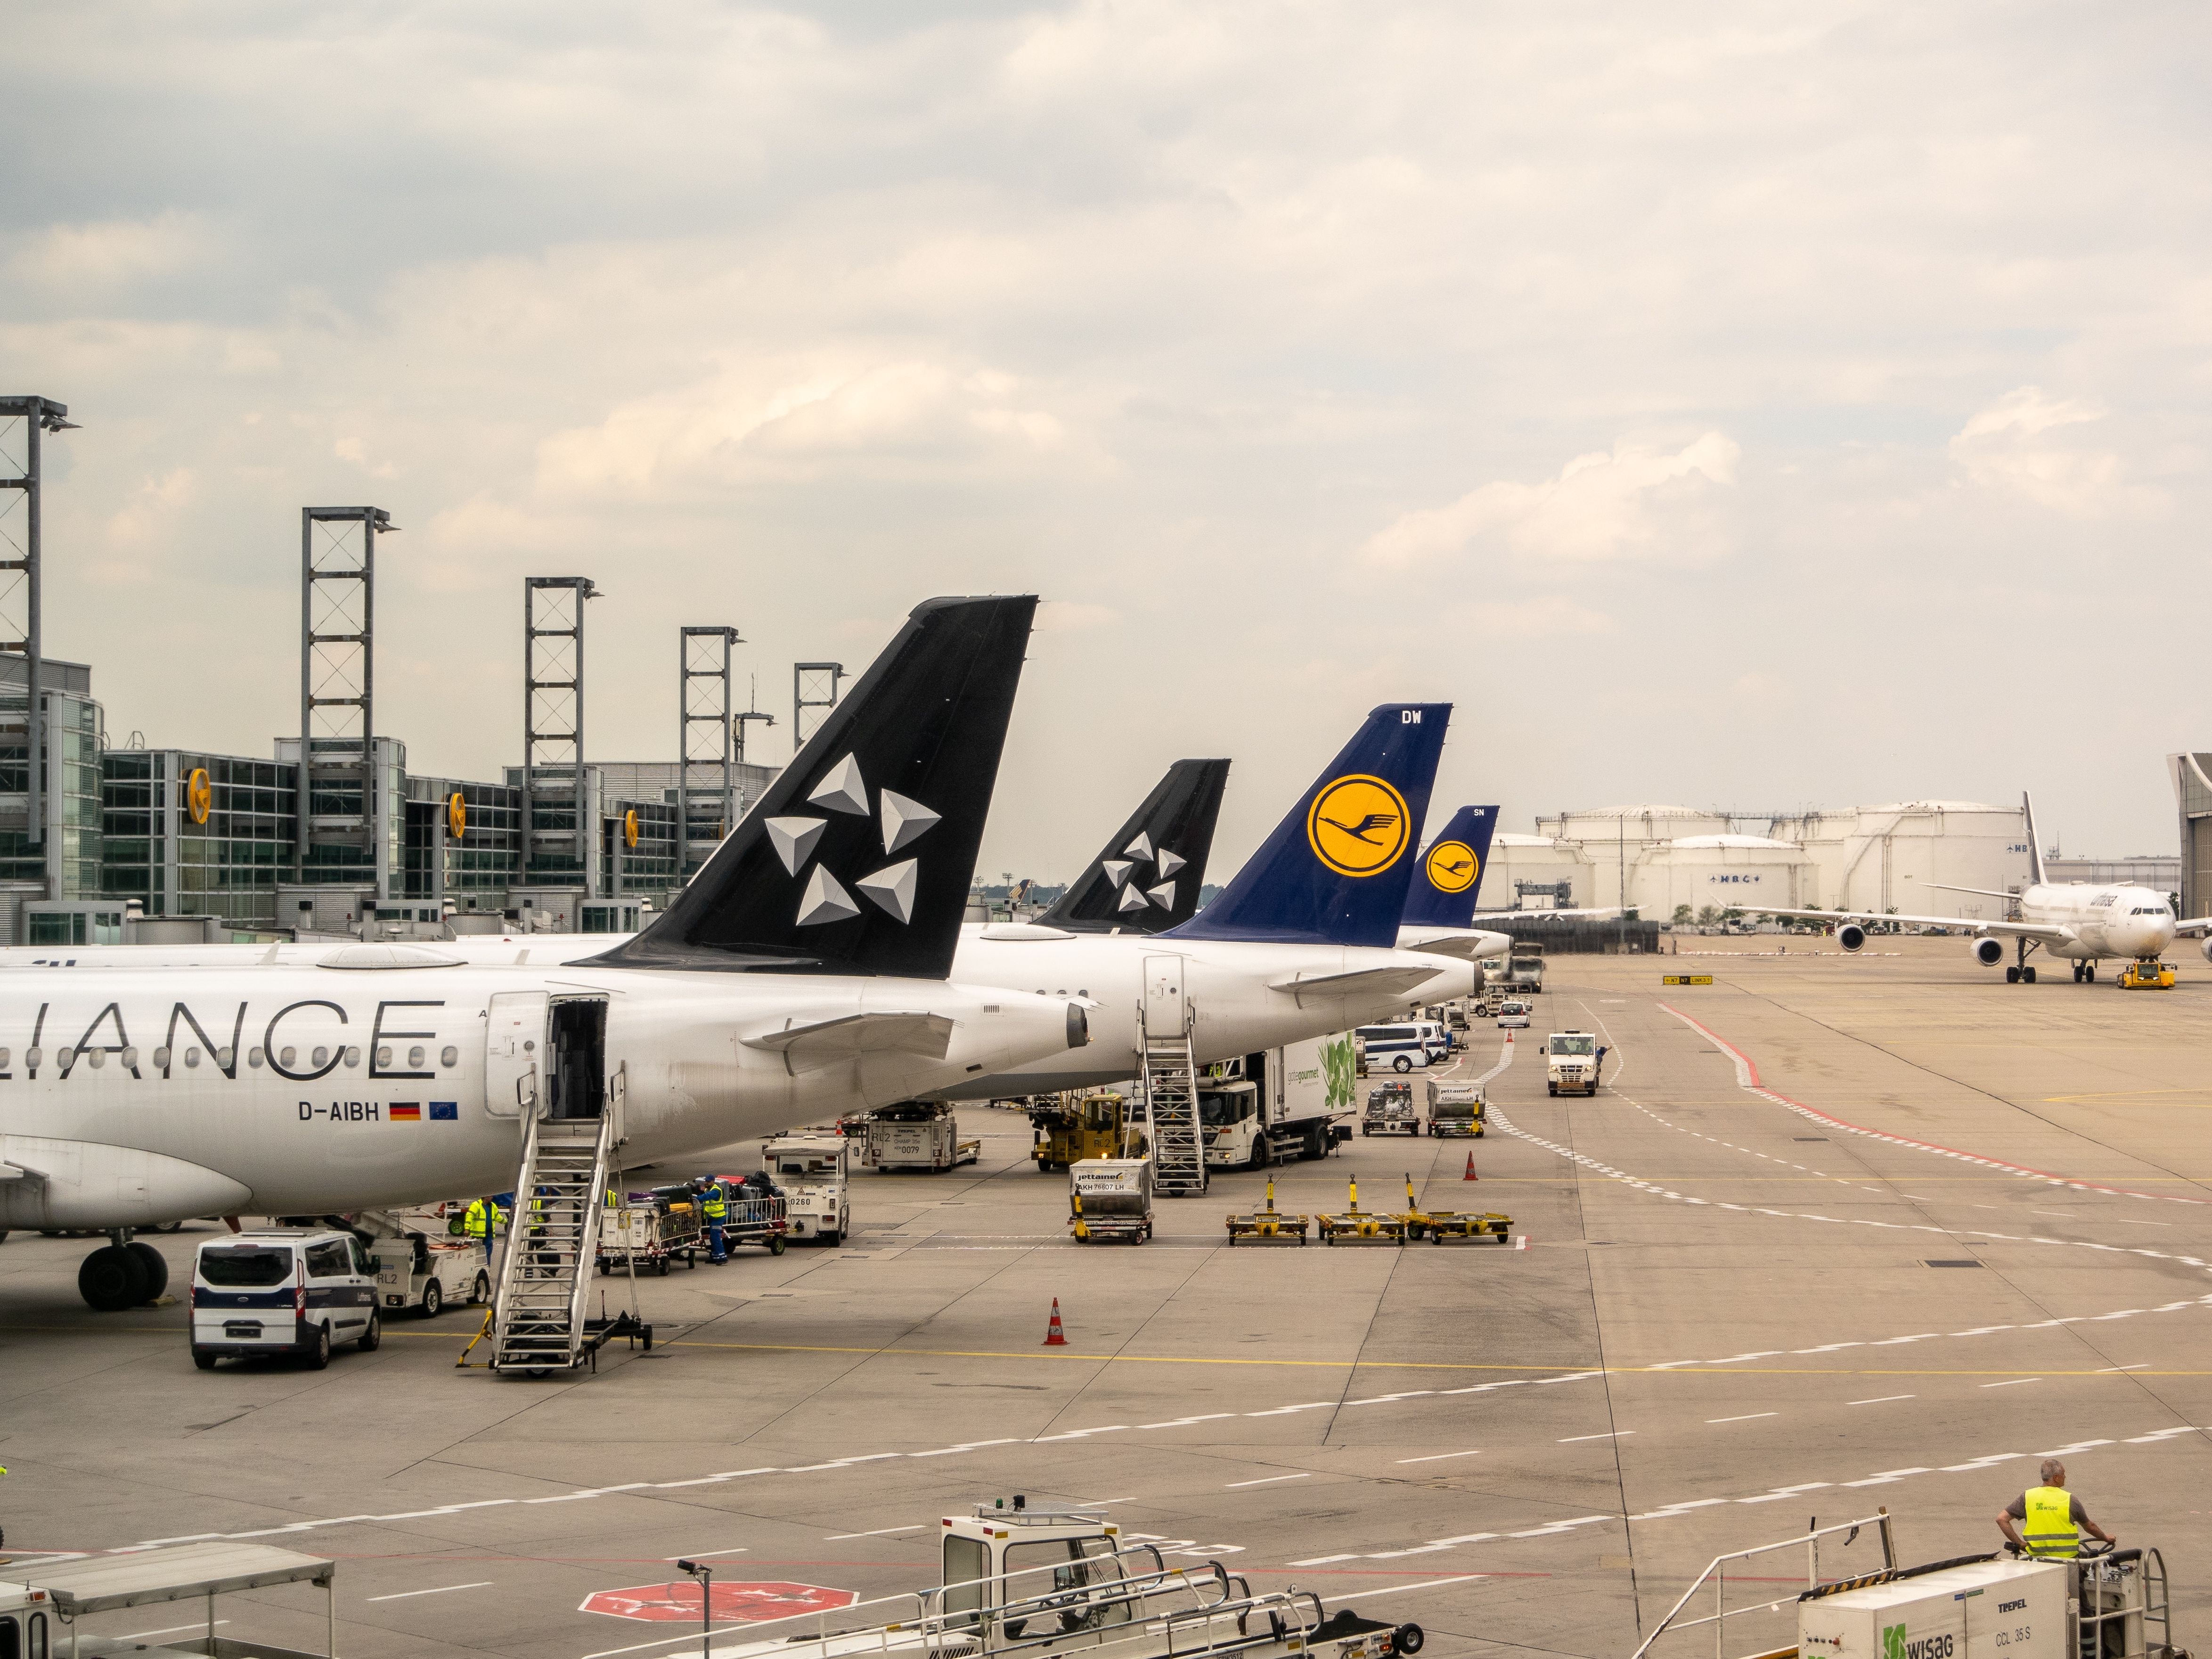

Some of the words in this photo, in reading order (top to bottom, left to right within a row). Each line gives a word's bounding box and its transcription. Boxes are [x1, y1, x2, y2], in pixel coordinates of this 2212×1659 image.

[1402, 711, 1421, 724] DW
[0, 1001, 445, 1080] IANCE
[1288, 1067, 1319, 1085] gategourmet
[299, 1102, 379, 1121] D-AIBH
[1078, 1172, 1123, 1181] jettainer
[377, 1274, 397, 1284] RL2
[1998, 1598, 2027, 1613] TREPEL
[1996, 1632, 2010, 1647] CCL
[2015, 1628, 2023, 1642] 35
[2025, 1626, 2031, 1639] S
